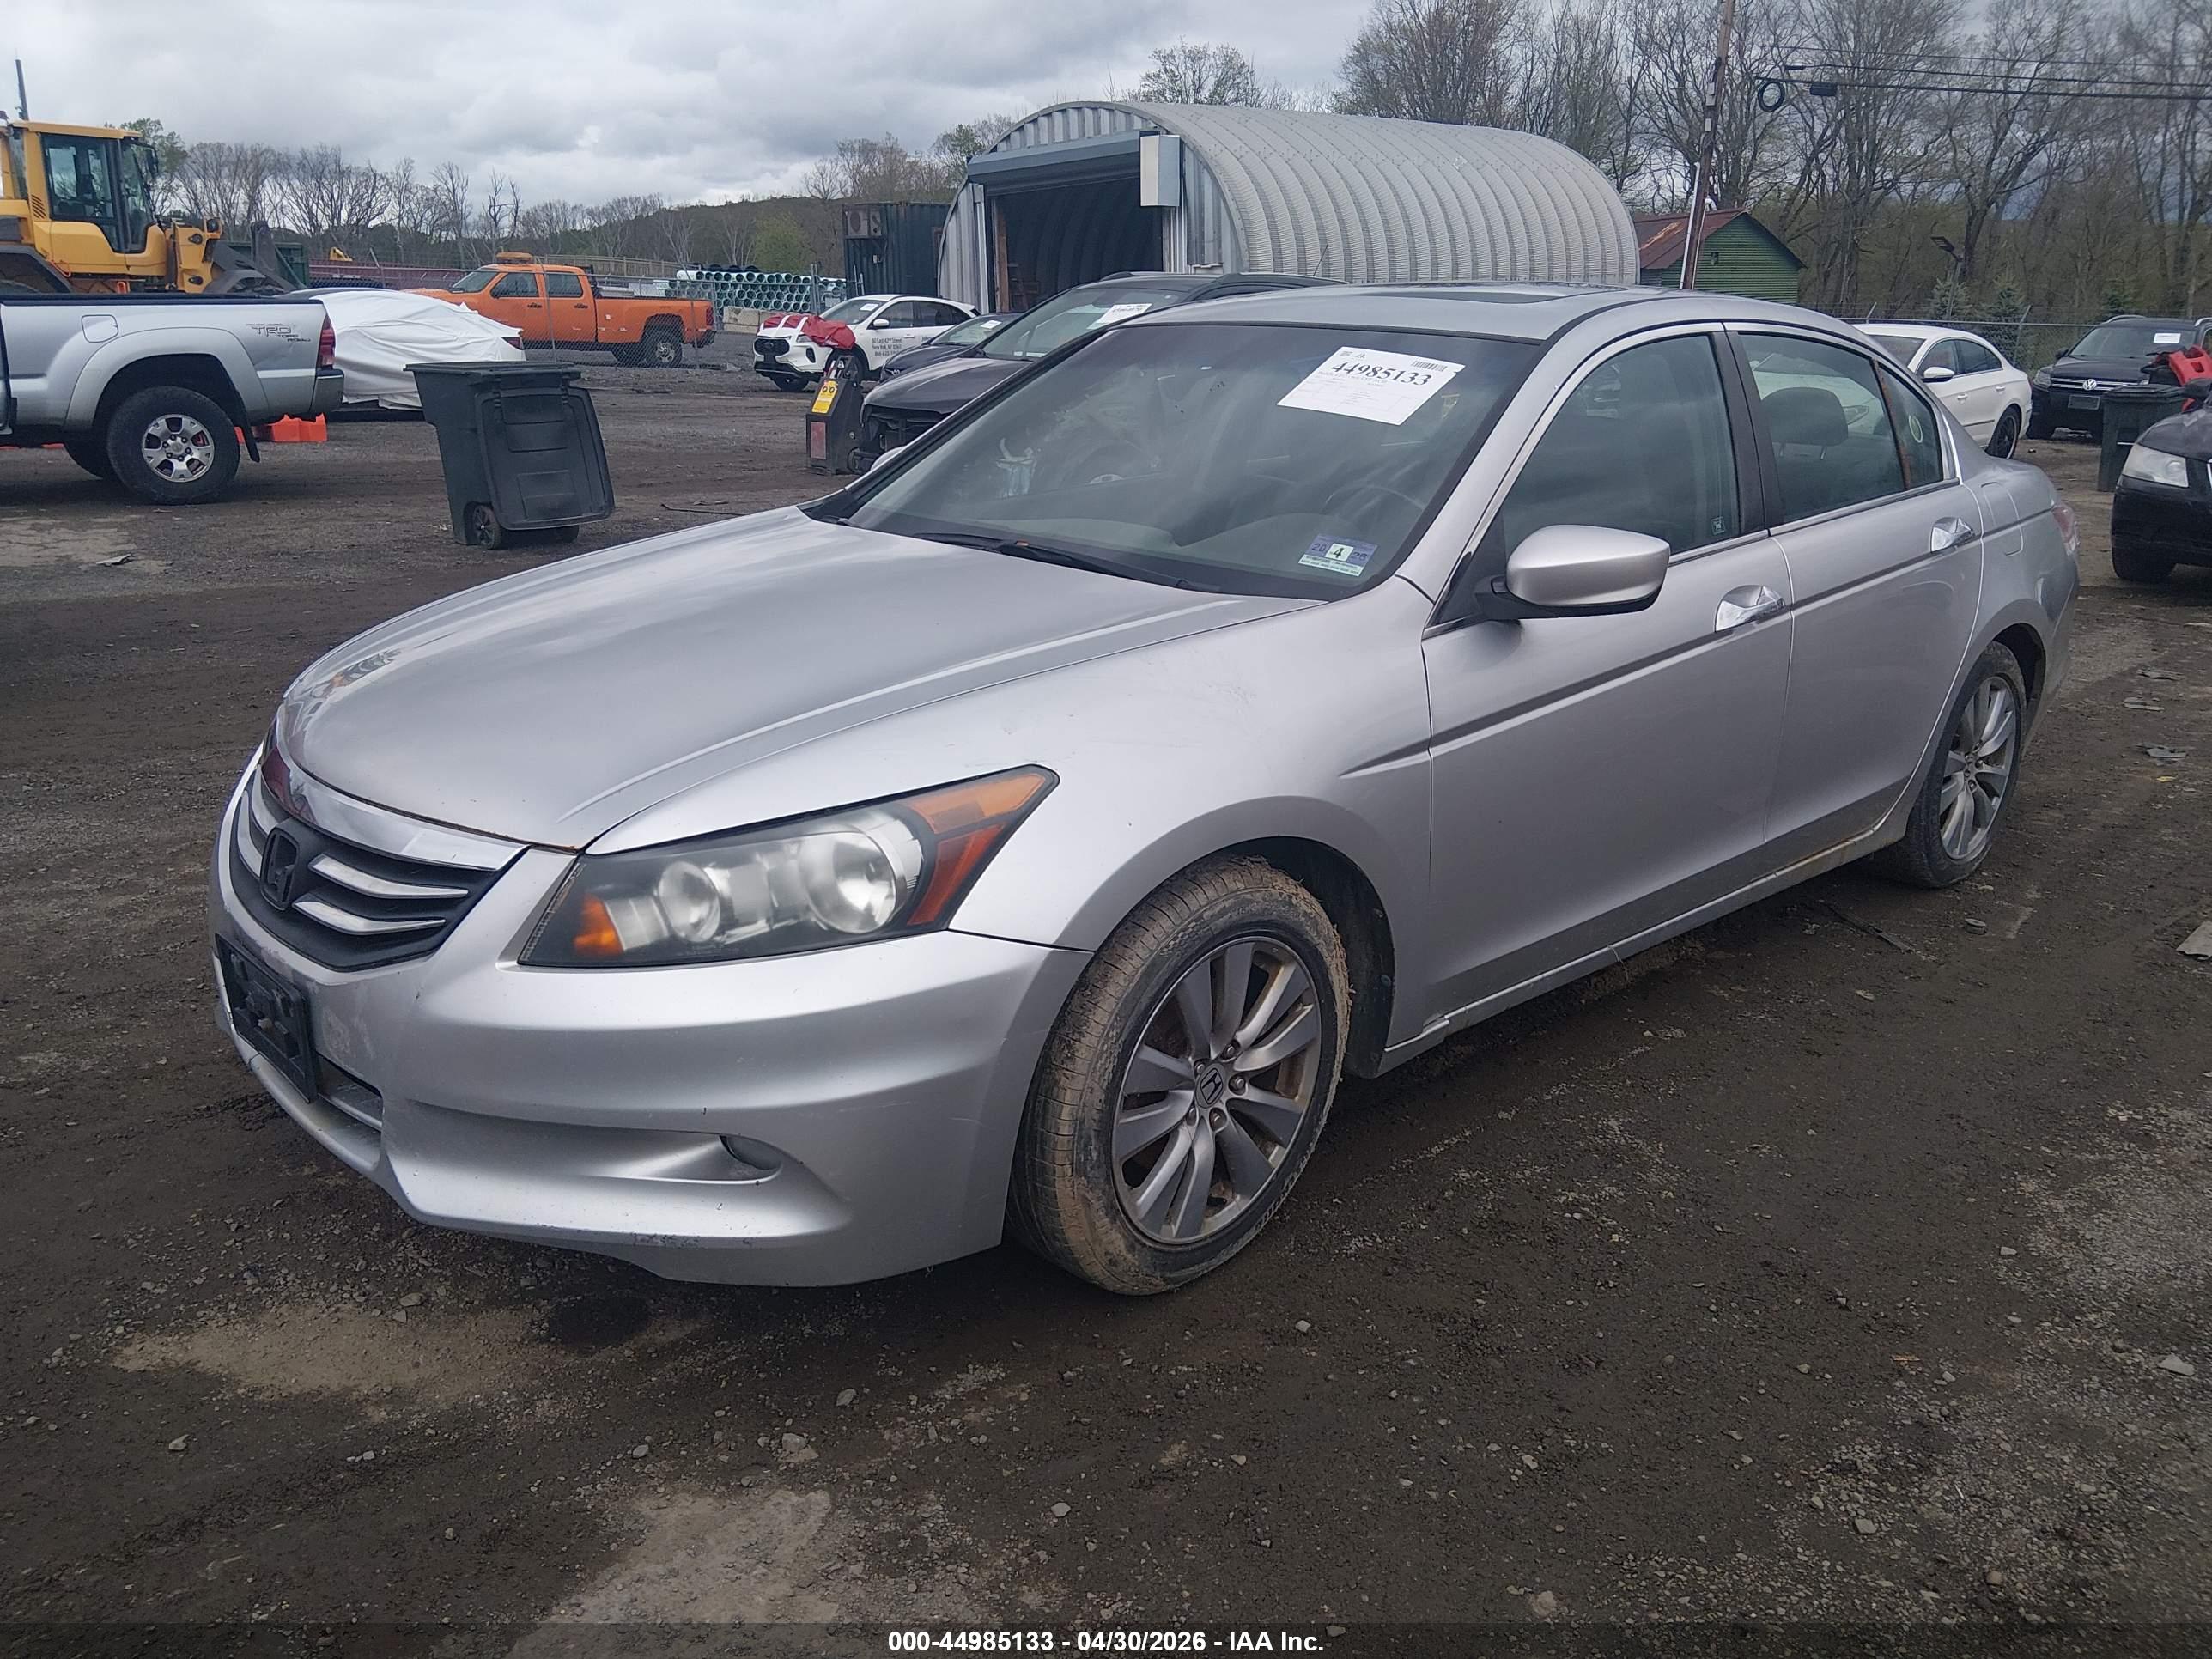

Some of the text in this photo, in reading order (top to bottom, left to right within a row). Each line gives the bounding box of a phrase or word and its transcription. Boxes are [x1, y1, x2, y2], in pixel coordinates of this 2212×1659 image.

[252, 326, 291, 337] TRD
[1332, 361, 1432, 386] 44985133
[1333, 547, 1345, 559] 4
